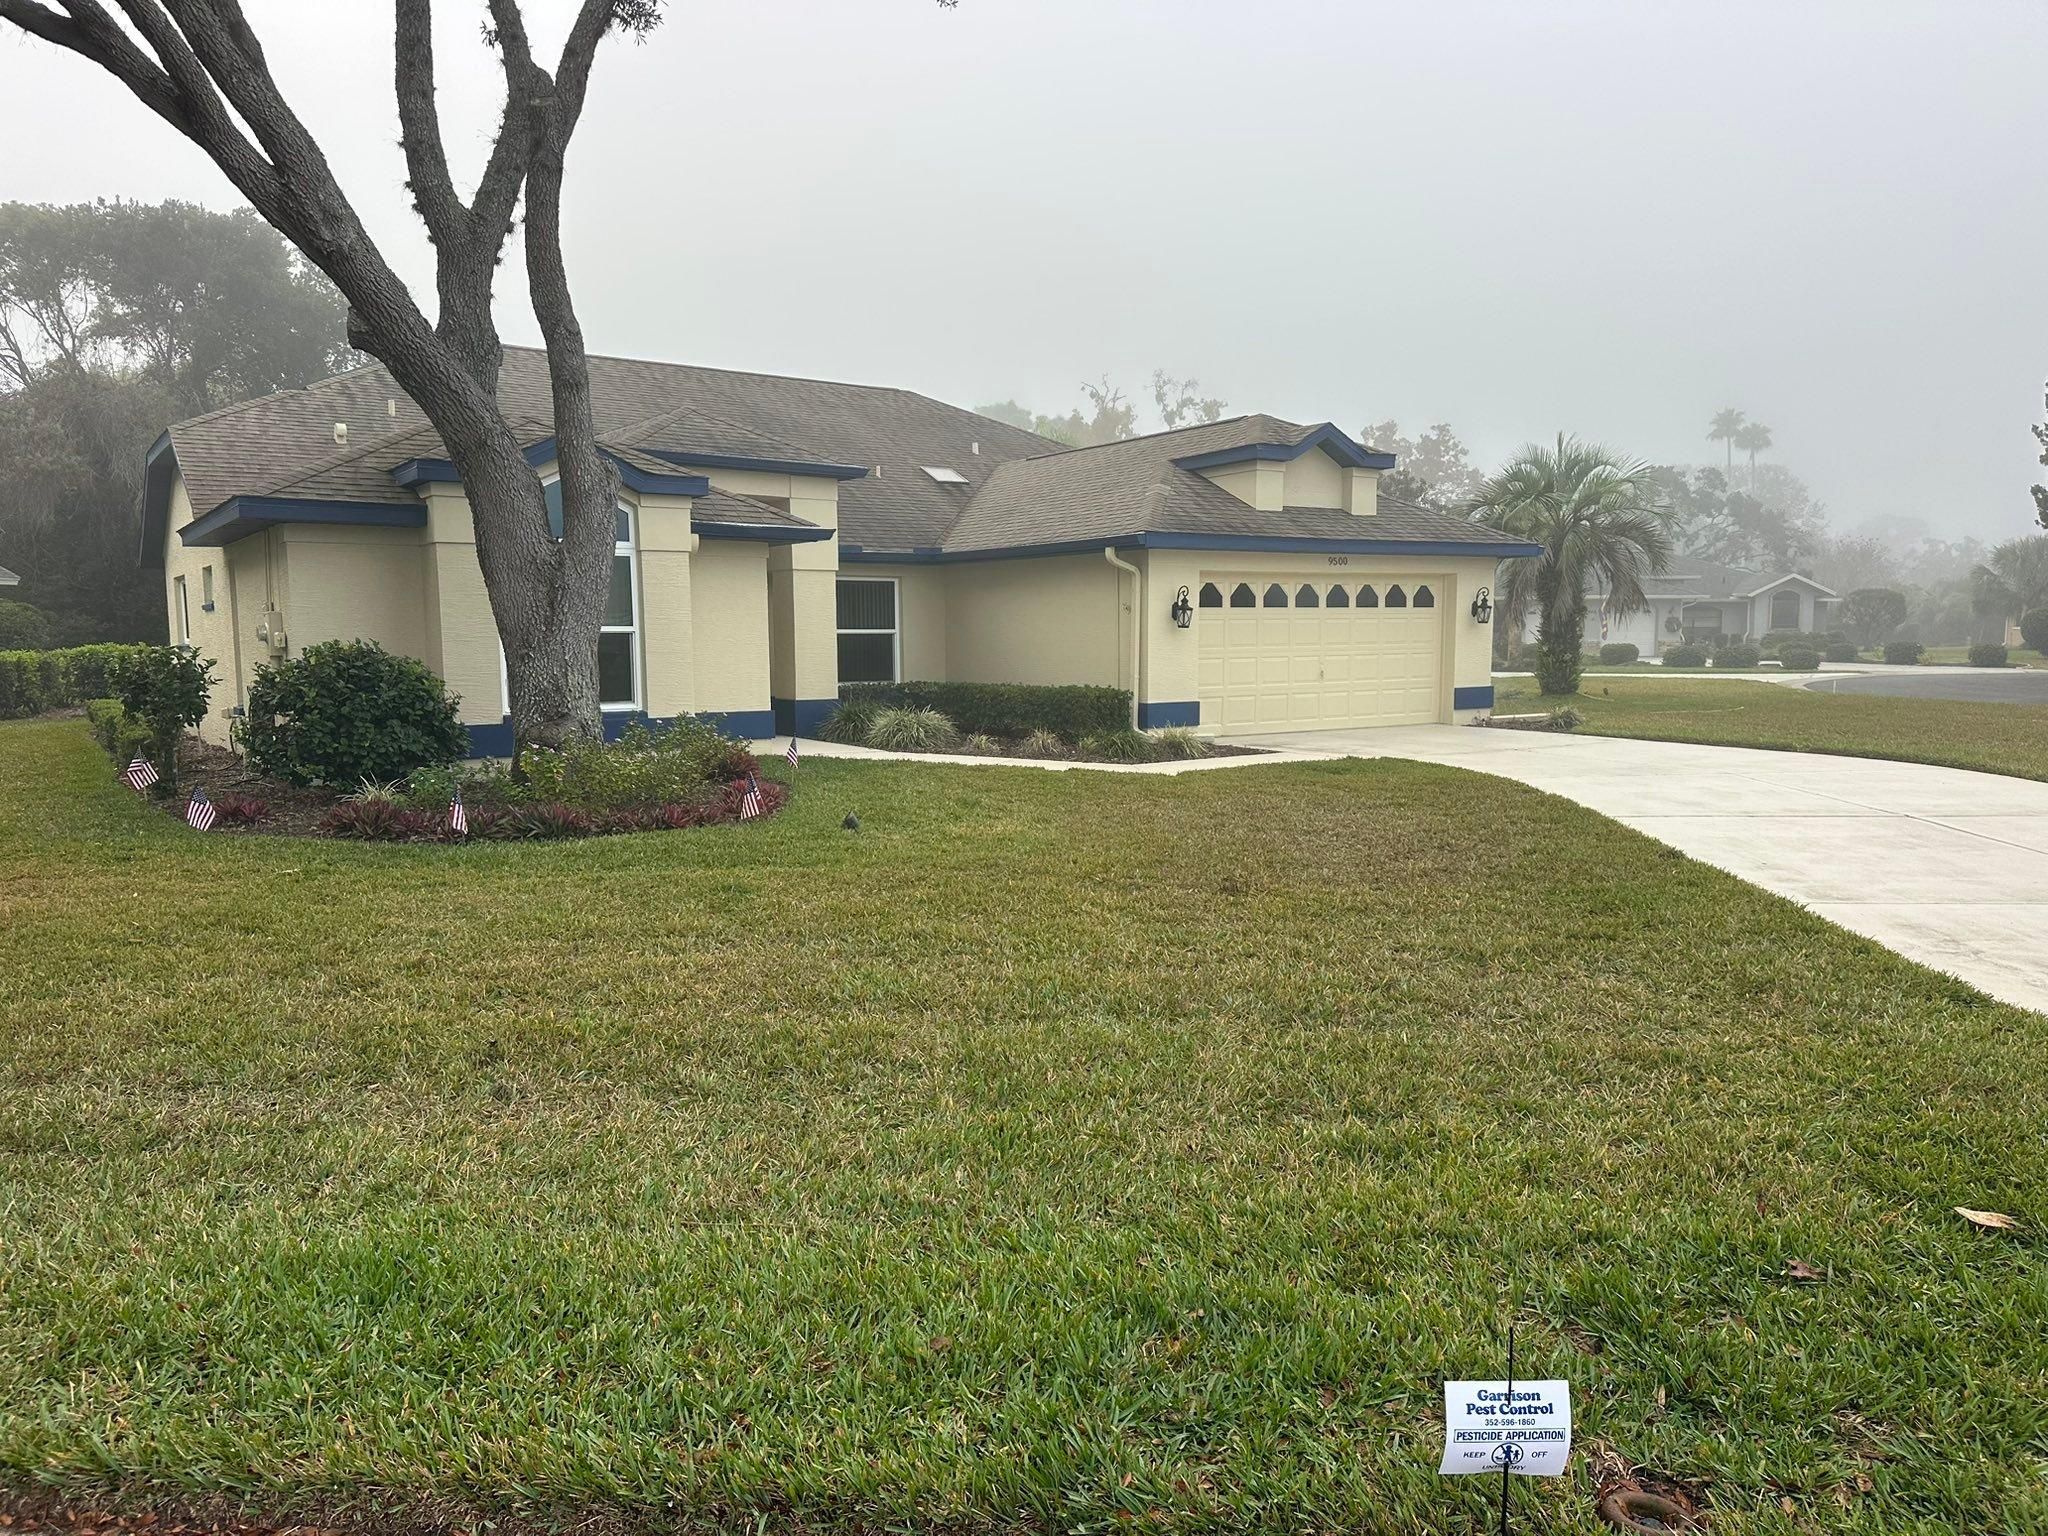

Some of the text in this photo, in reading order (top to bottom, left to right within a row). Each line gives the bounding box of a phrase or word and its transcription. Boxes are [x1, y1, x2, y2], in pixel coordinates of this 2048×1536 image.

[1328, 556, 1348, 566] 9500
[1477, 1389, 1541, 1402] Garrison
[1466, 1403, 1554, 1415] Pest Control
[1485, 1418, 1536, 1426] 352-596-1860
[1456, 1430, 1564, 1441] PESTICIDE APPLICATION
[1463, 1450, 1548, 1459] KEEP OFF
